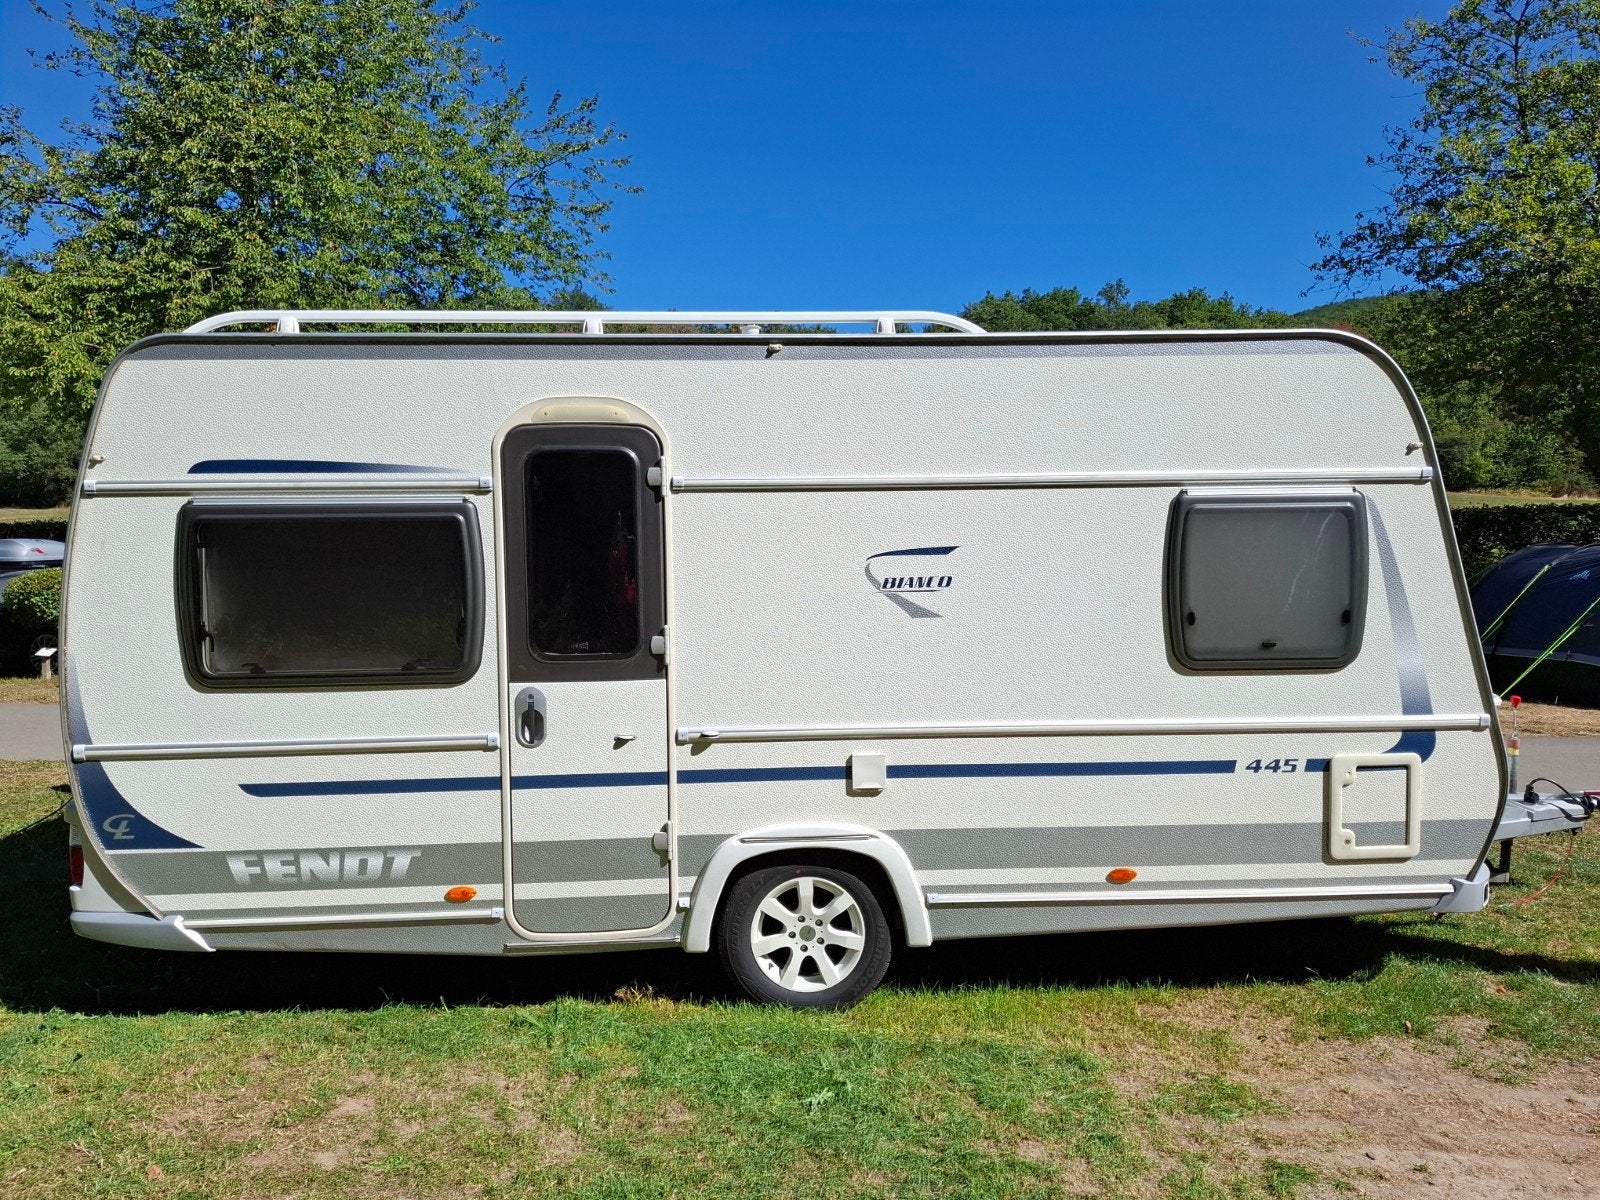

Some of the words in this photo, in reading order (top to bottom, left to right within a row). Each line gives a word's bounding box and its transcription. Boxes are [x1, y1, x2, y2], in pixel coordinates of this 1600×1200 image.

[881, 575, 953, 590] BIANCO
[1245, 758, 1299, 773] 445
[225, 849, 423, 885] FENDT
